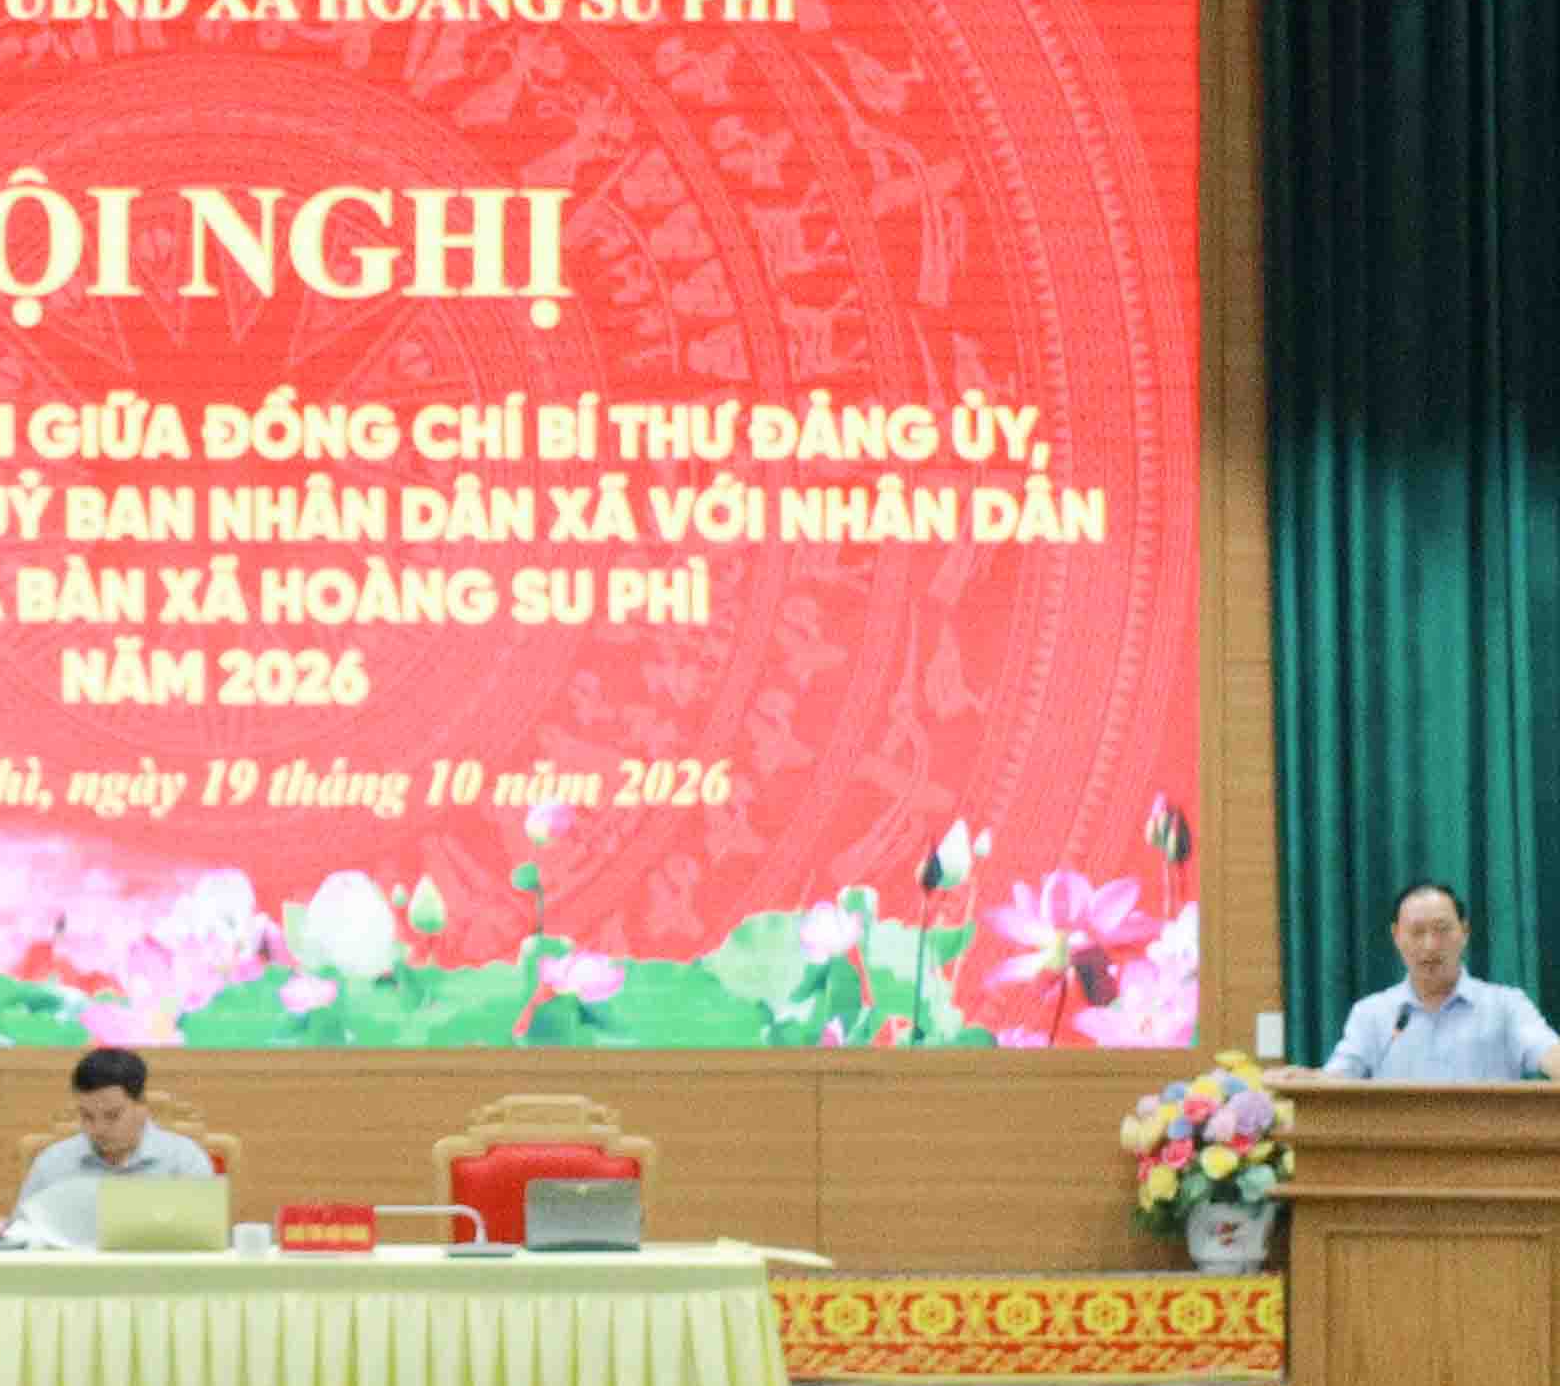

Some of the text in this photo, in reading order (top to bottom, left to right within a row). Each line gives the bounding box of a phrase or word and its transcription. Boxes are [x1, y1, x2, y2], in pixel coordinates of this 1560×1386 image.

[181, 188, 569, 327] NGHỊ
[29, 392, 189, 458] GIỮA
[413, 393, 524, 459] CHÍ
[539, 393, 597, 459] BÍ
[610, 401, 739, 459] THƯ
[749, 391, 938, 459] ĐẢNG
[67, 487, 193, 540] BAN
[210, 474, 386, 541] NHÂN
[402, 474, 533, 541] DÂN
[550, 474, 637, 541] XÃ
[650, 473, 764, 542] VỚI
[781, 475, 956, 541] NHÂN
[973, 475, 1104, 542] DÂN
[17, 556, 145, 622] BÀN
[161, 556, 248, 623] XÃ
[262, 557, 498, 624] HOÀNG
[512, 569, 593, 624] SU
[609, 557, 709, 624] PHÌ
[62, 637, 369, 705] NĂM 2026
[67, 758, 186, 817] ngày
[203, 760, 258, 805] 19
[269, 758, 409, 817] tháng
[428, 760, 482, 805] 10
[614, 760, 730, 805] 2026
